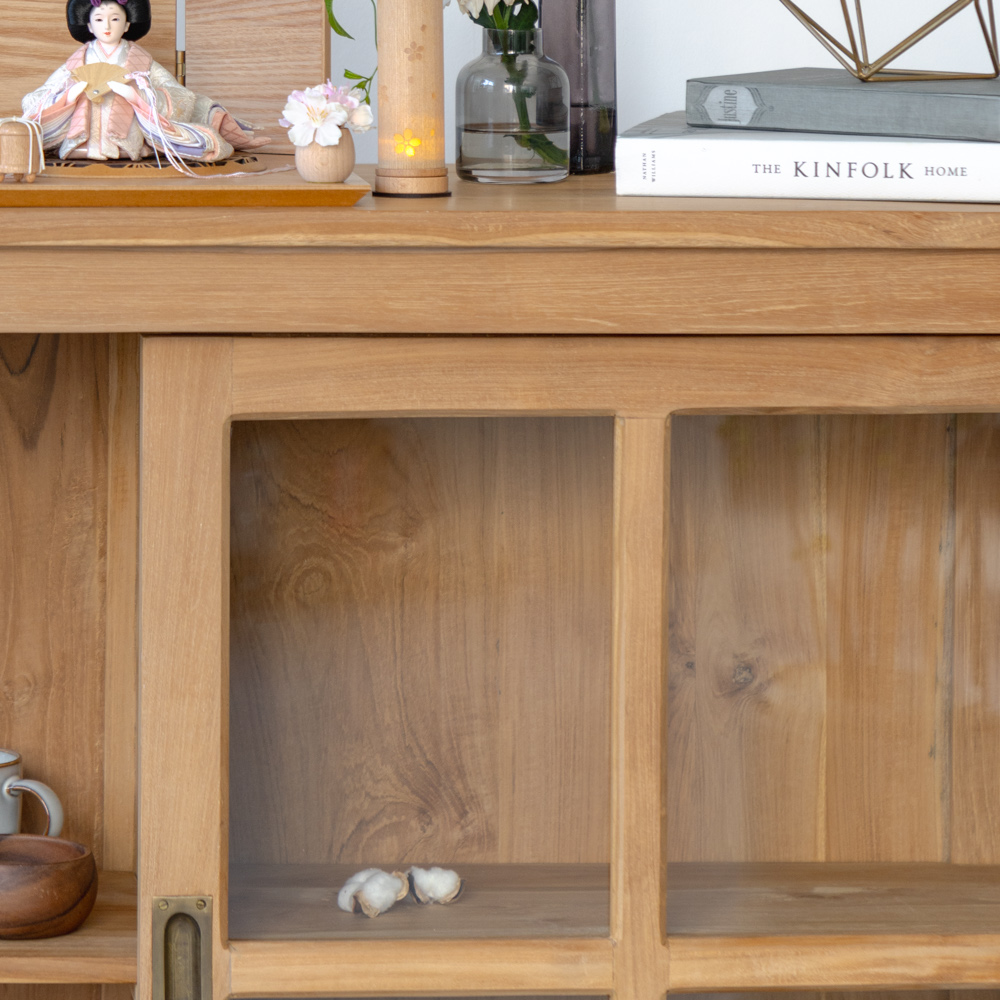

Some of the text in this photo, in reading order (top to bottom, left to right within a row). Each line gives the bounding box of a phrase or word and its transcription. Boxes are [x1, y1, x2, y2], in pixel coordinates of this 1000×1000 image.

[718, 89, 741, 124] Justine
[752, 161, 968, 179] THE KINFOLK HOME
